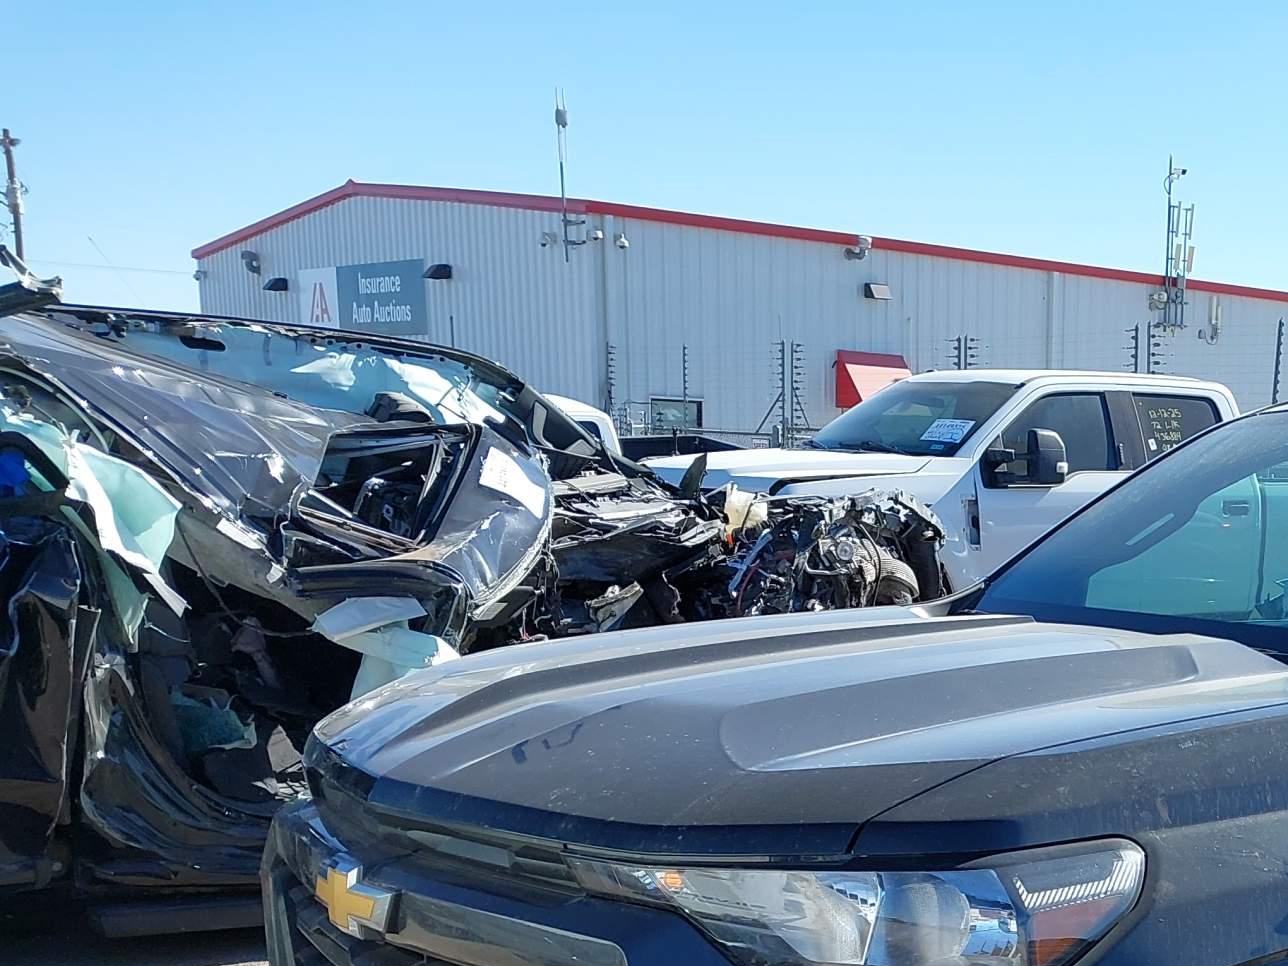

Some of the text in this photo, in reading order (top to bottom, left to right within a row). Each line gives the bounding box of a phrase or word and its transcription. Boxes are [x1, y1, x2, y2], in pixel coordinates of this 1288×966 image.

[358, 272, 401, 295] Insurance
[352, 300, 412, 323] Auto Auctions
